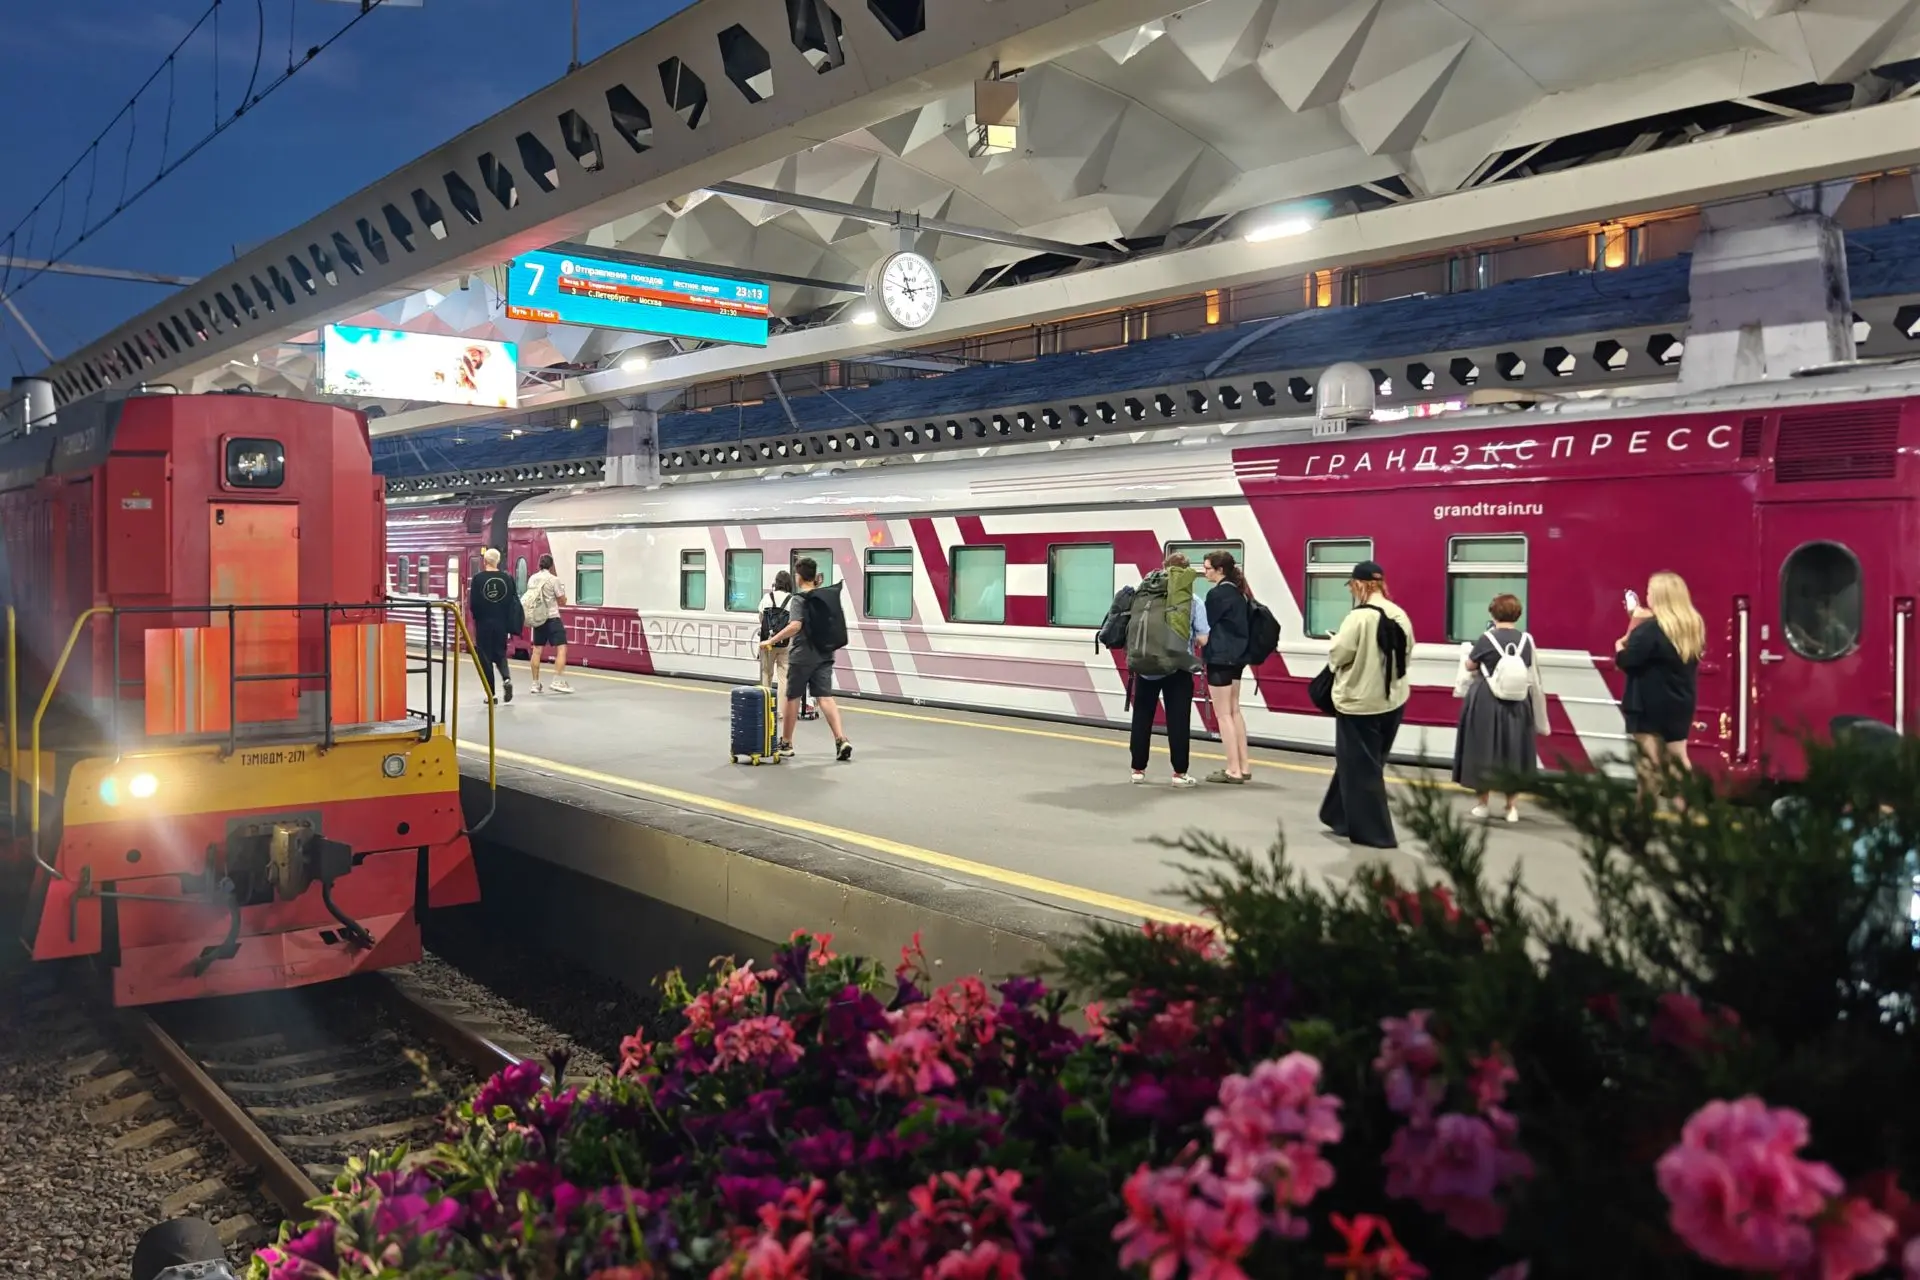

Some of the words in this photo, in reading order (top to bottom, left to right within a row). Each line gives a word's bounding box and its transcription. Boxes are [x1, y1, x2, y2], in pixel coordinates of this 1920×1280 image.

[524, 262, 545, 296] 7
[639, 297, 662, 307] Москва
[735, 286, 763, 300] 23:13
[719, 307, 737, 317] 23:30
[1305, 425, 1733, 475] ГРАНДЭКСПРЕСС
[1433, 501, 1544, 520] grandtrain.ru
[574, 615, 761, 659] ГРАНДЭКСПРЕС
